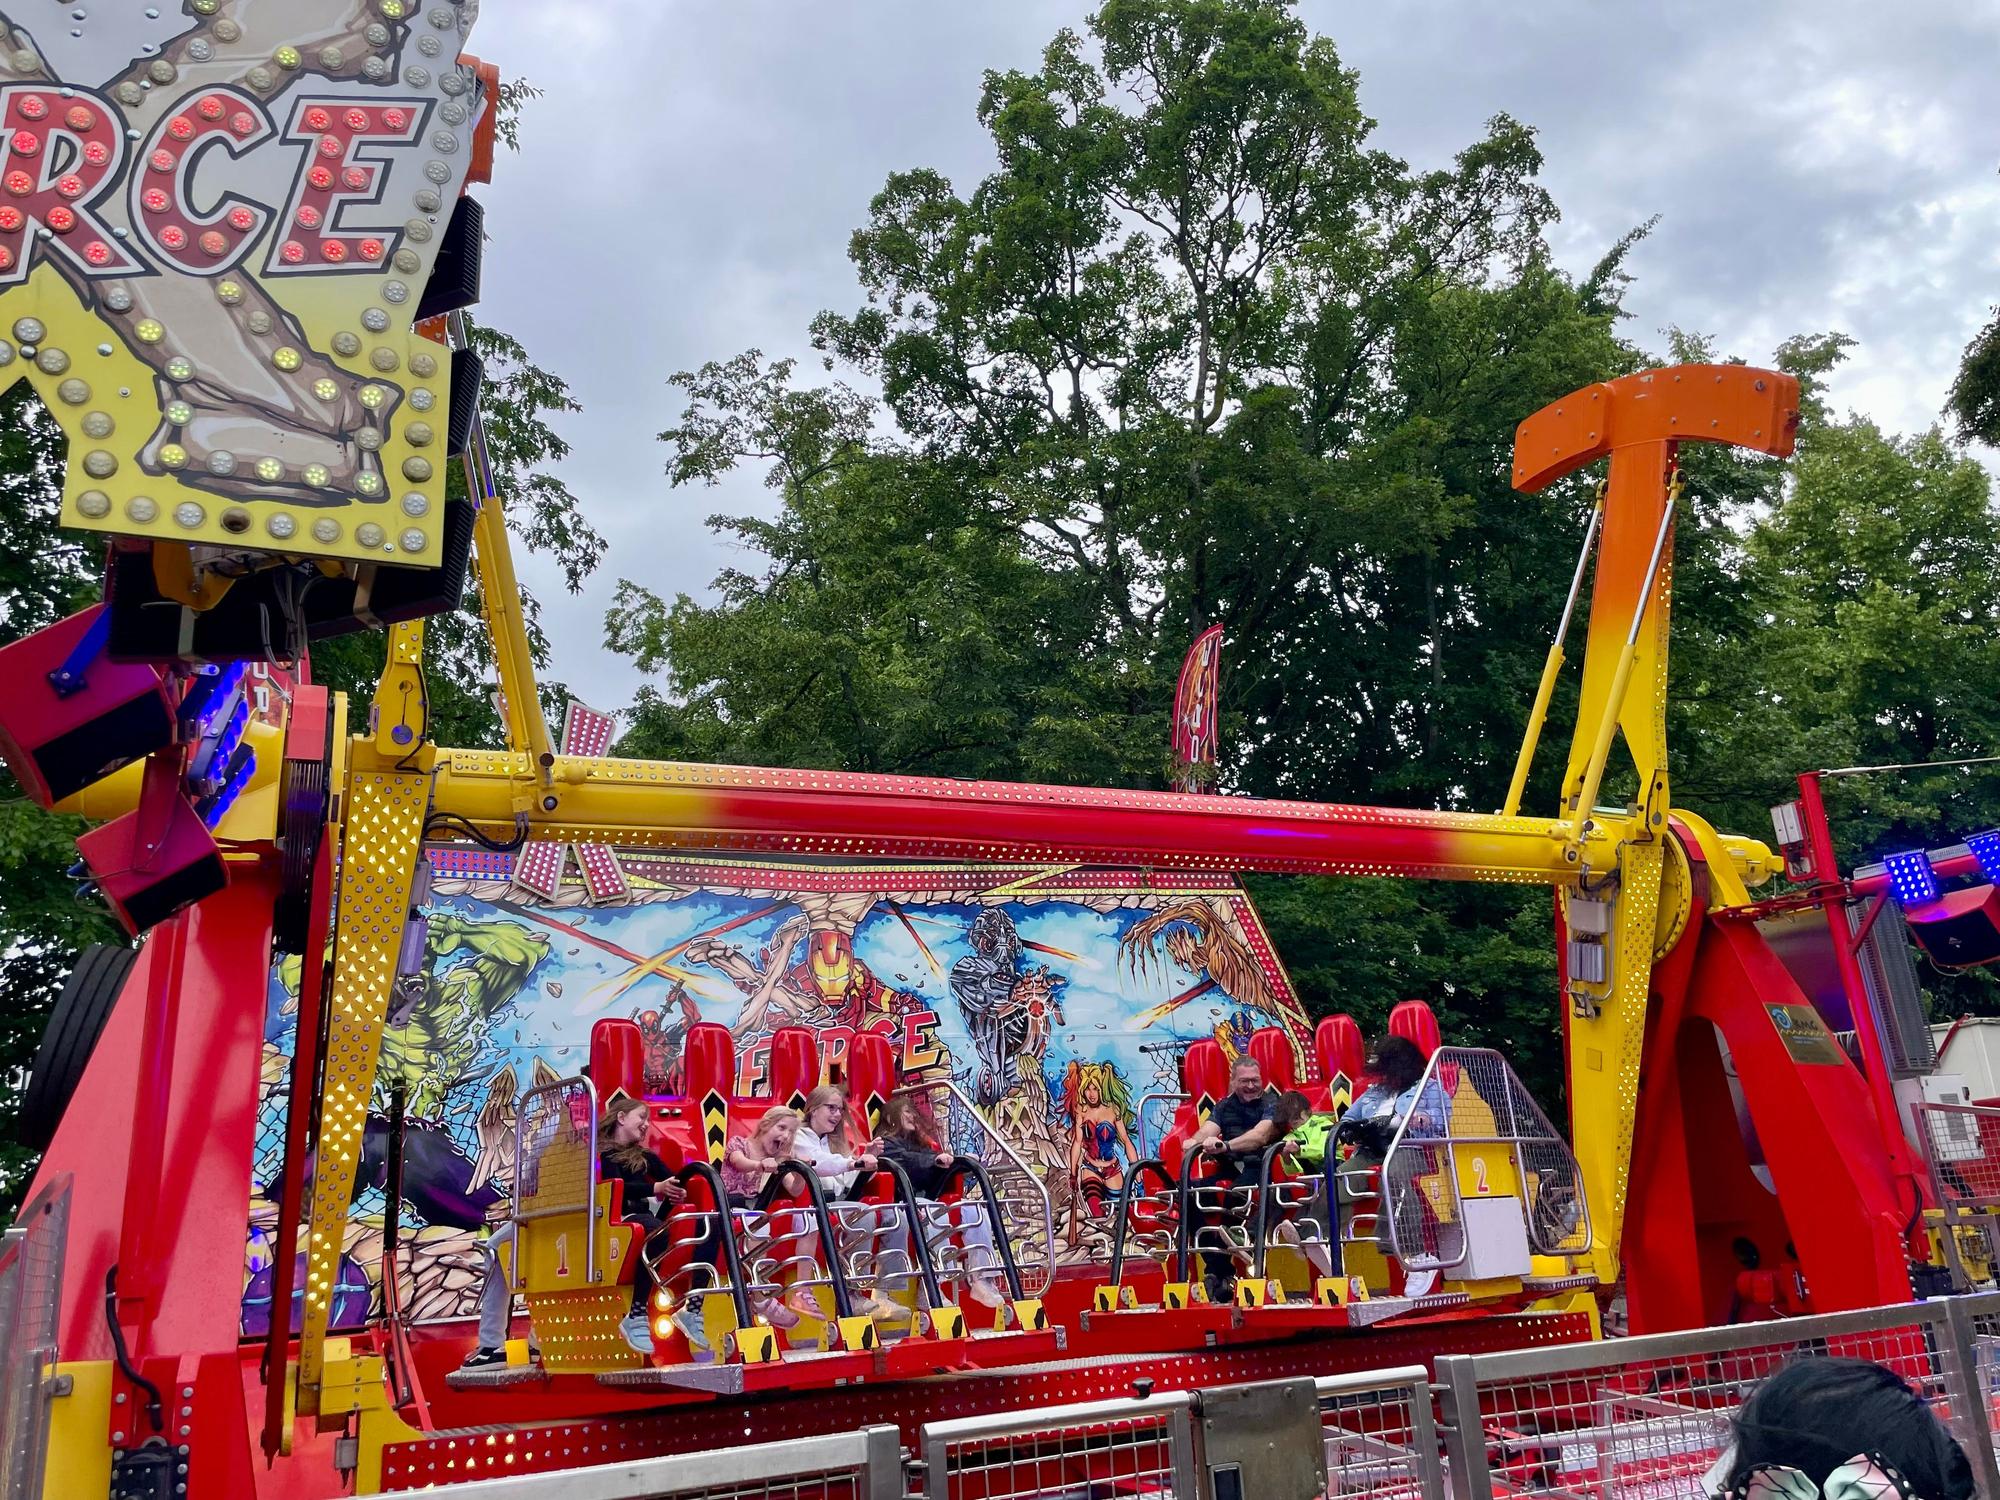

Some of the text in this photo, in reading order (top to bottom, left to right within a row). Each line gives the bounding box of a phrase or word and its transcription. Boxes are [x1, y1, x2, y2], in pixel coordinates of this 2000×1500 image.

[1472, 1157, 1490, 1193] 2
[555, 1232, 569, 1277] 1
[609, 1237, 620, 1260] B
